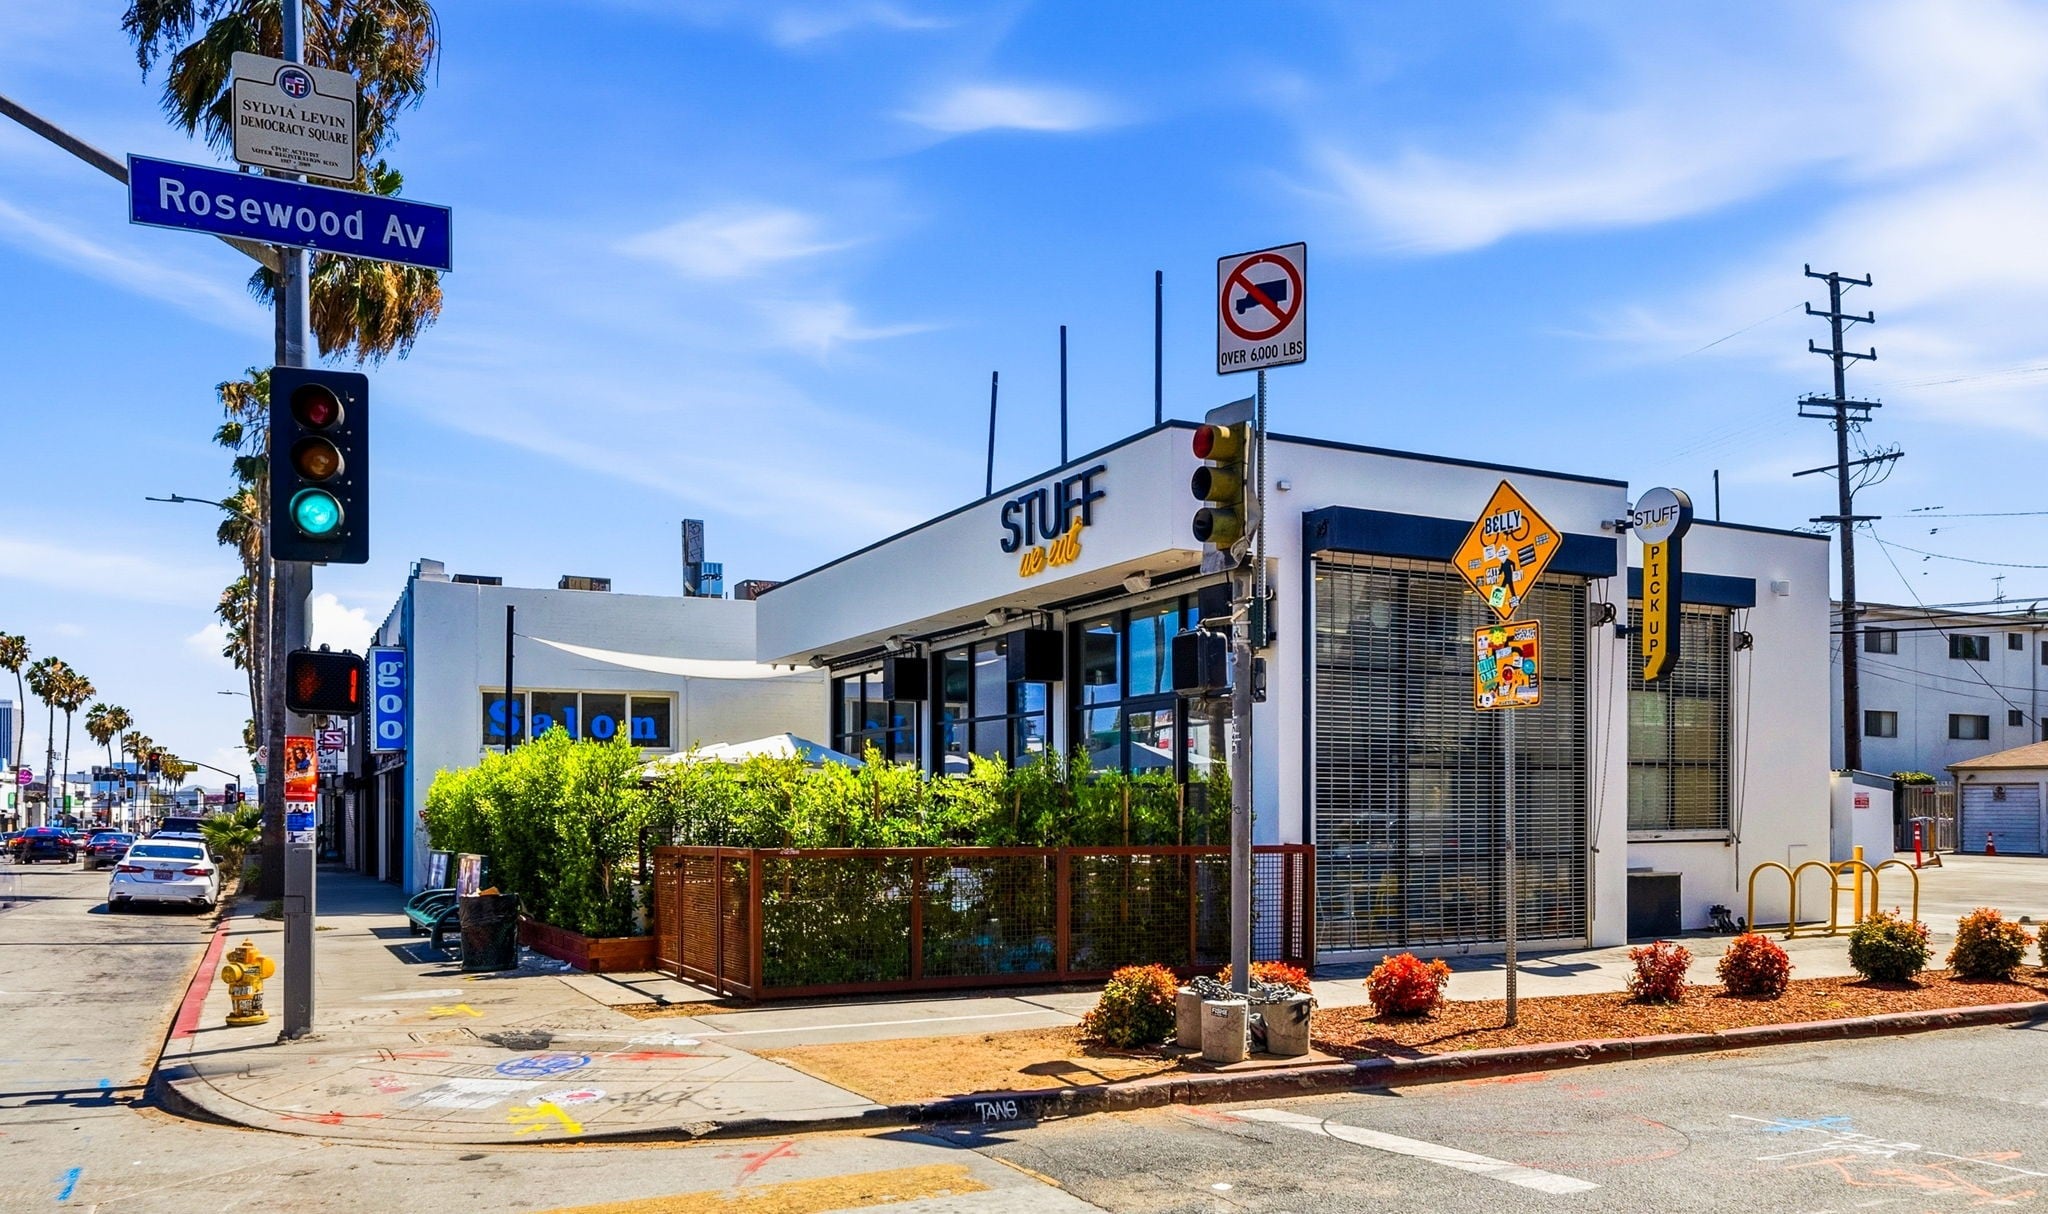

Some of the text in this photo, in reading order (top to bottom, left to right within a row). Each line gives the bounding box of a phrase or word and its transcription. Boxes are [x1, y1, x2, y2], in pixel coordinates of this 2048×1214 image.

[240, 114, 349, 145] DEMOCRACY SQUARE
[242, 99, 345, 128] SYLVIA LEVIN
[251, 147, 273, 156] VOTER
[159, 177, 426, 249] Rosewood Av
[1221, 349, 1247, 366] OVER
[1250, 344, 1278, 363] 6,000
[1283, 340, 1303, 356] LBS
[1000, 464, 1107, 553] STUFF
[1485, 510, 1521, 534] BELLY
[1634, 504, 1679, 526] STUFF
[1019, 515, 1084, 578] we eat
[1649, 546, 1661, 653] PICK UP
[377, 661, 404, 740] goo
[488, 699, 658, 740] Salon
